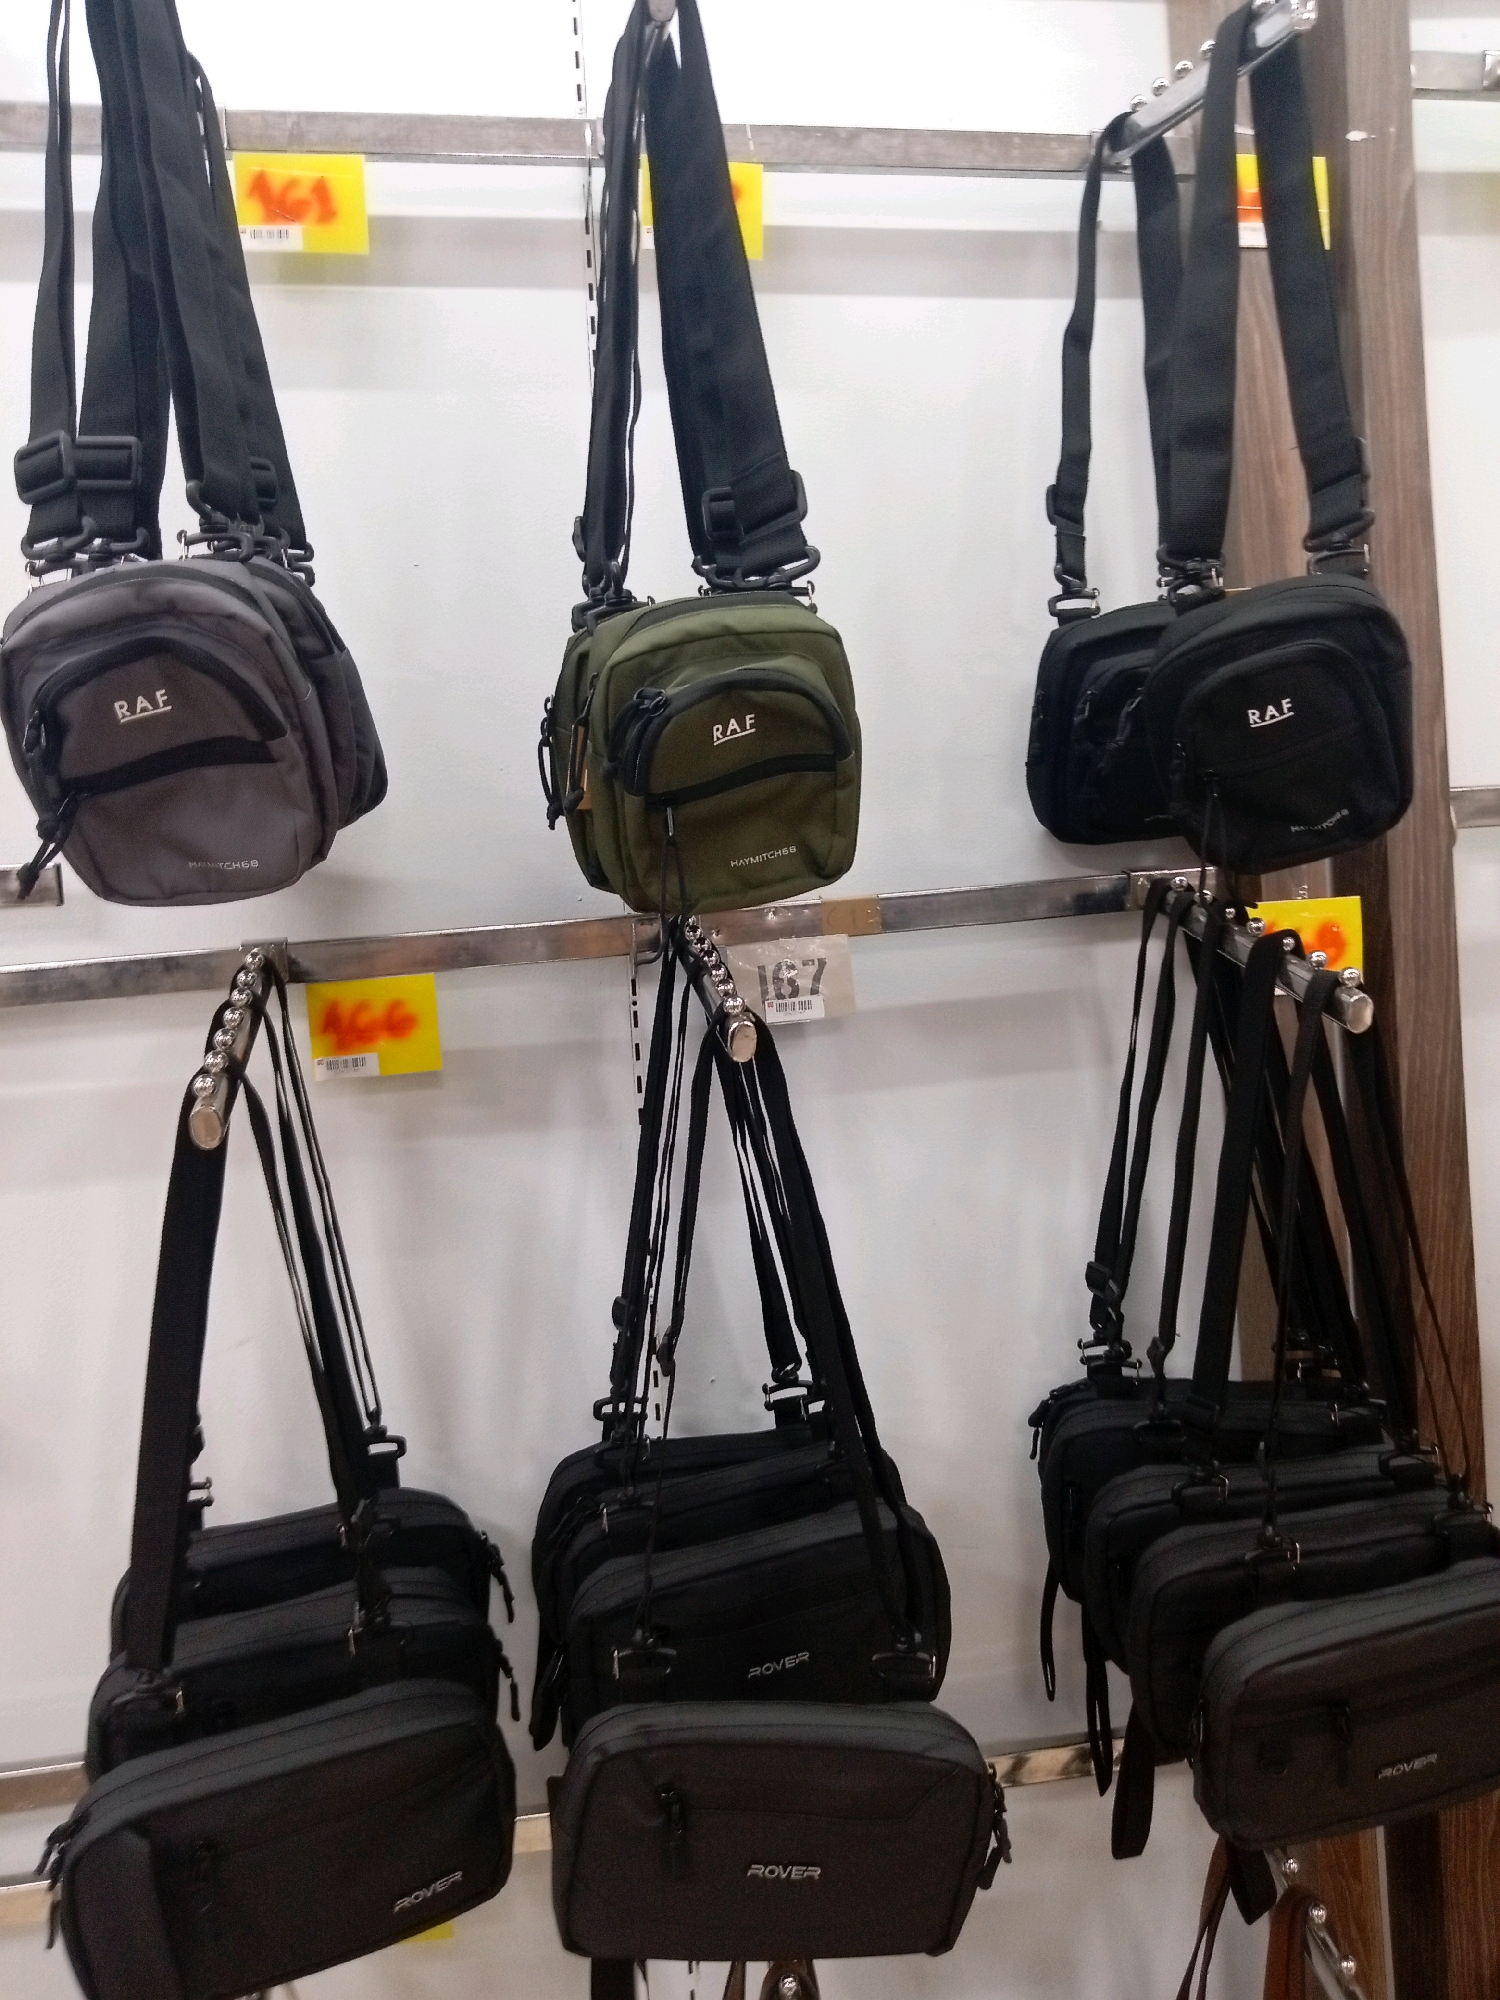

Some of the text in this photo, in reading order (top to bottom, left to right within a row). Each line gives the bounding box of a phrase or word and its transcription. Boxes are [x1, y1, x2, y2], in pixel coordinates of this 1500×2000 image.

[113, 689, 170, 720] RAF
[1246, 697, 1293, 726] RAF
[712, 713, 756, 743] RAF
[730, 845, 797, 868] HAYMITCH68
[757, 956, 828, 1004] 167
[747, 1651, 810, 1680] ROVER
[1378, 1753, 1438, 1780] ROVER
[746, 1864, 822, 1881] ROVER
[393, 1870, 464, 1914] ROVER
